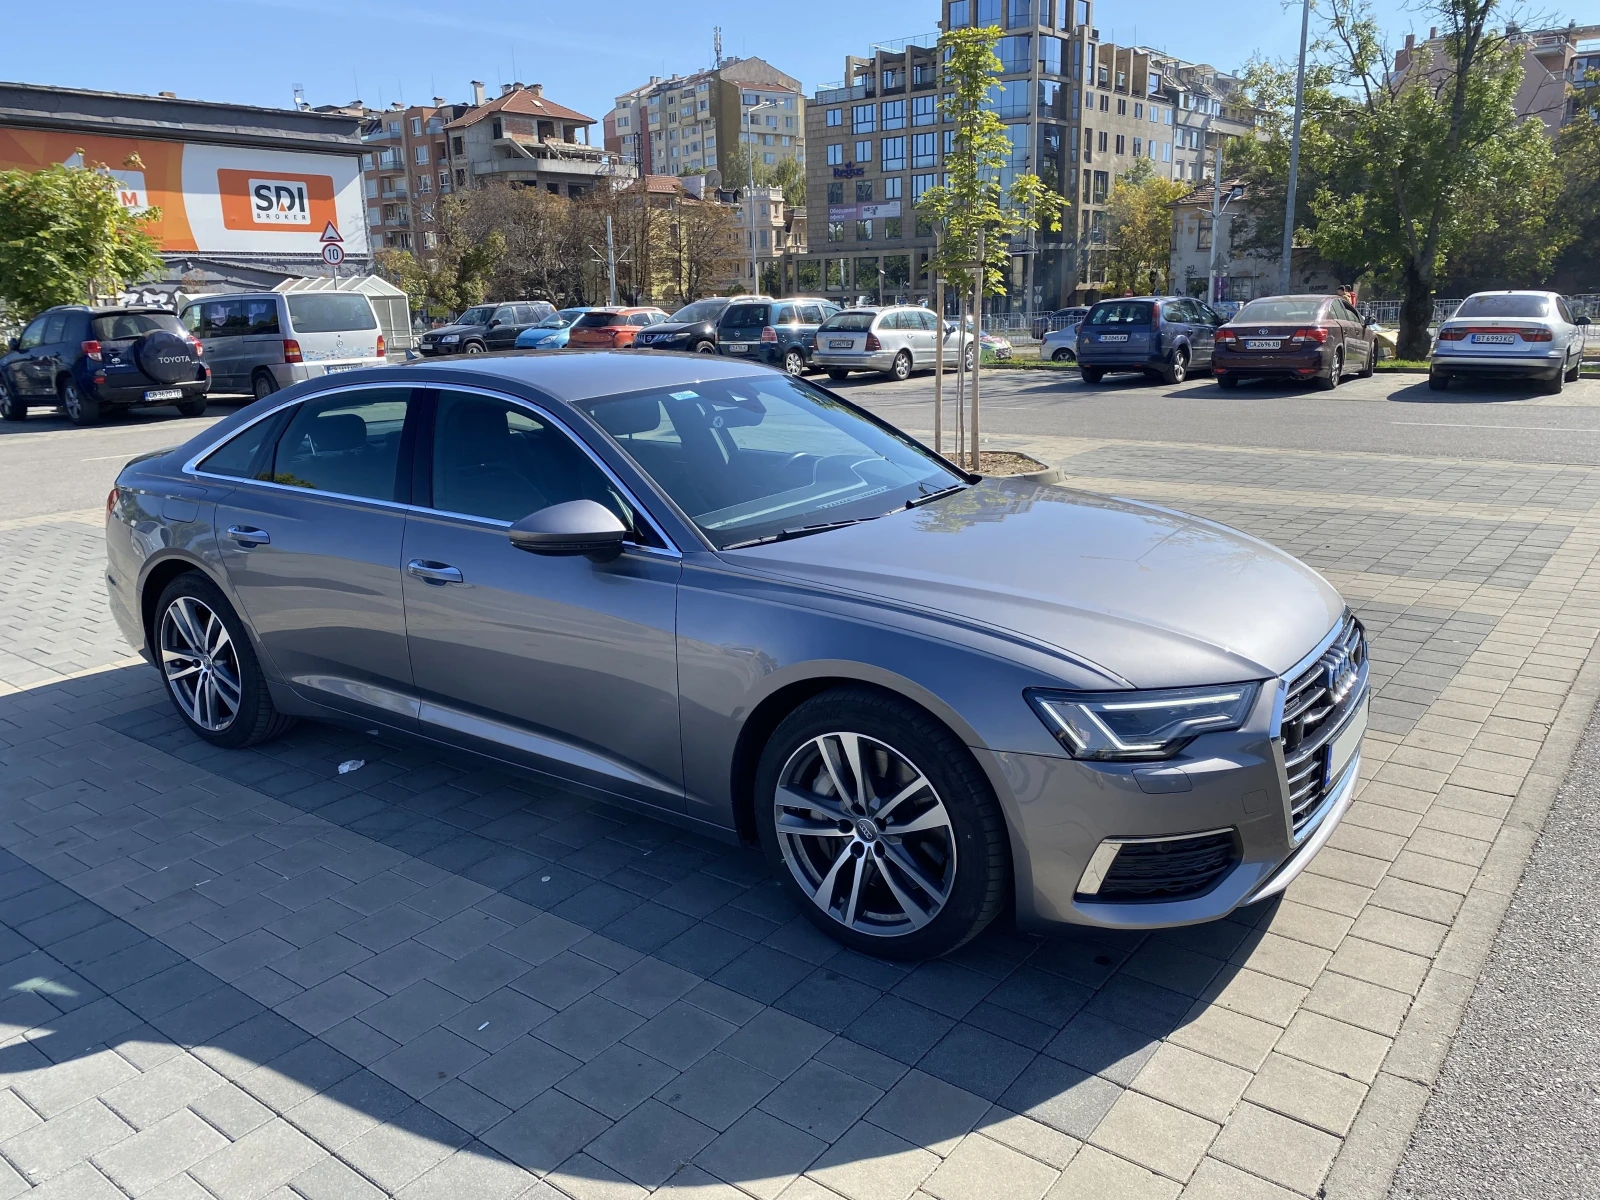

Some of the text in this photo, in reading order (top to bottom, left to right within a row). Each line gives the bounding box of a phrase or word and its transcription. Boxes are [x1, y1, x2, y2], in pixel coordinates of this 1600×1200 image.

[833, 167, 865, 179] Regus
[254, 184, 306, 212] SDI
[328, 248, 339, 260] 10
[158, 355, 191, 364] TOYOTA
